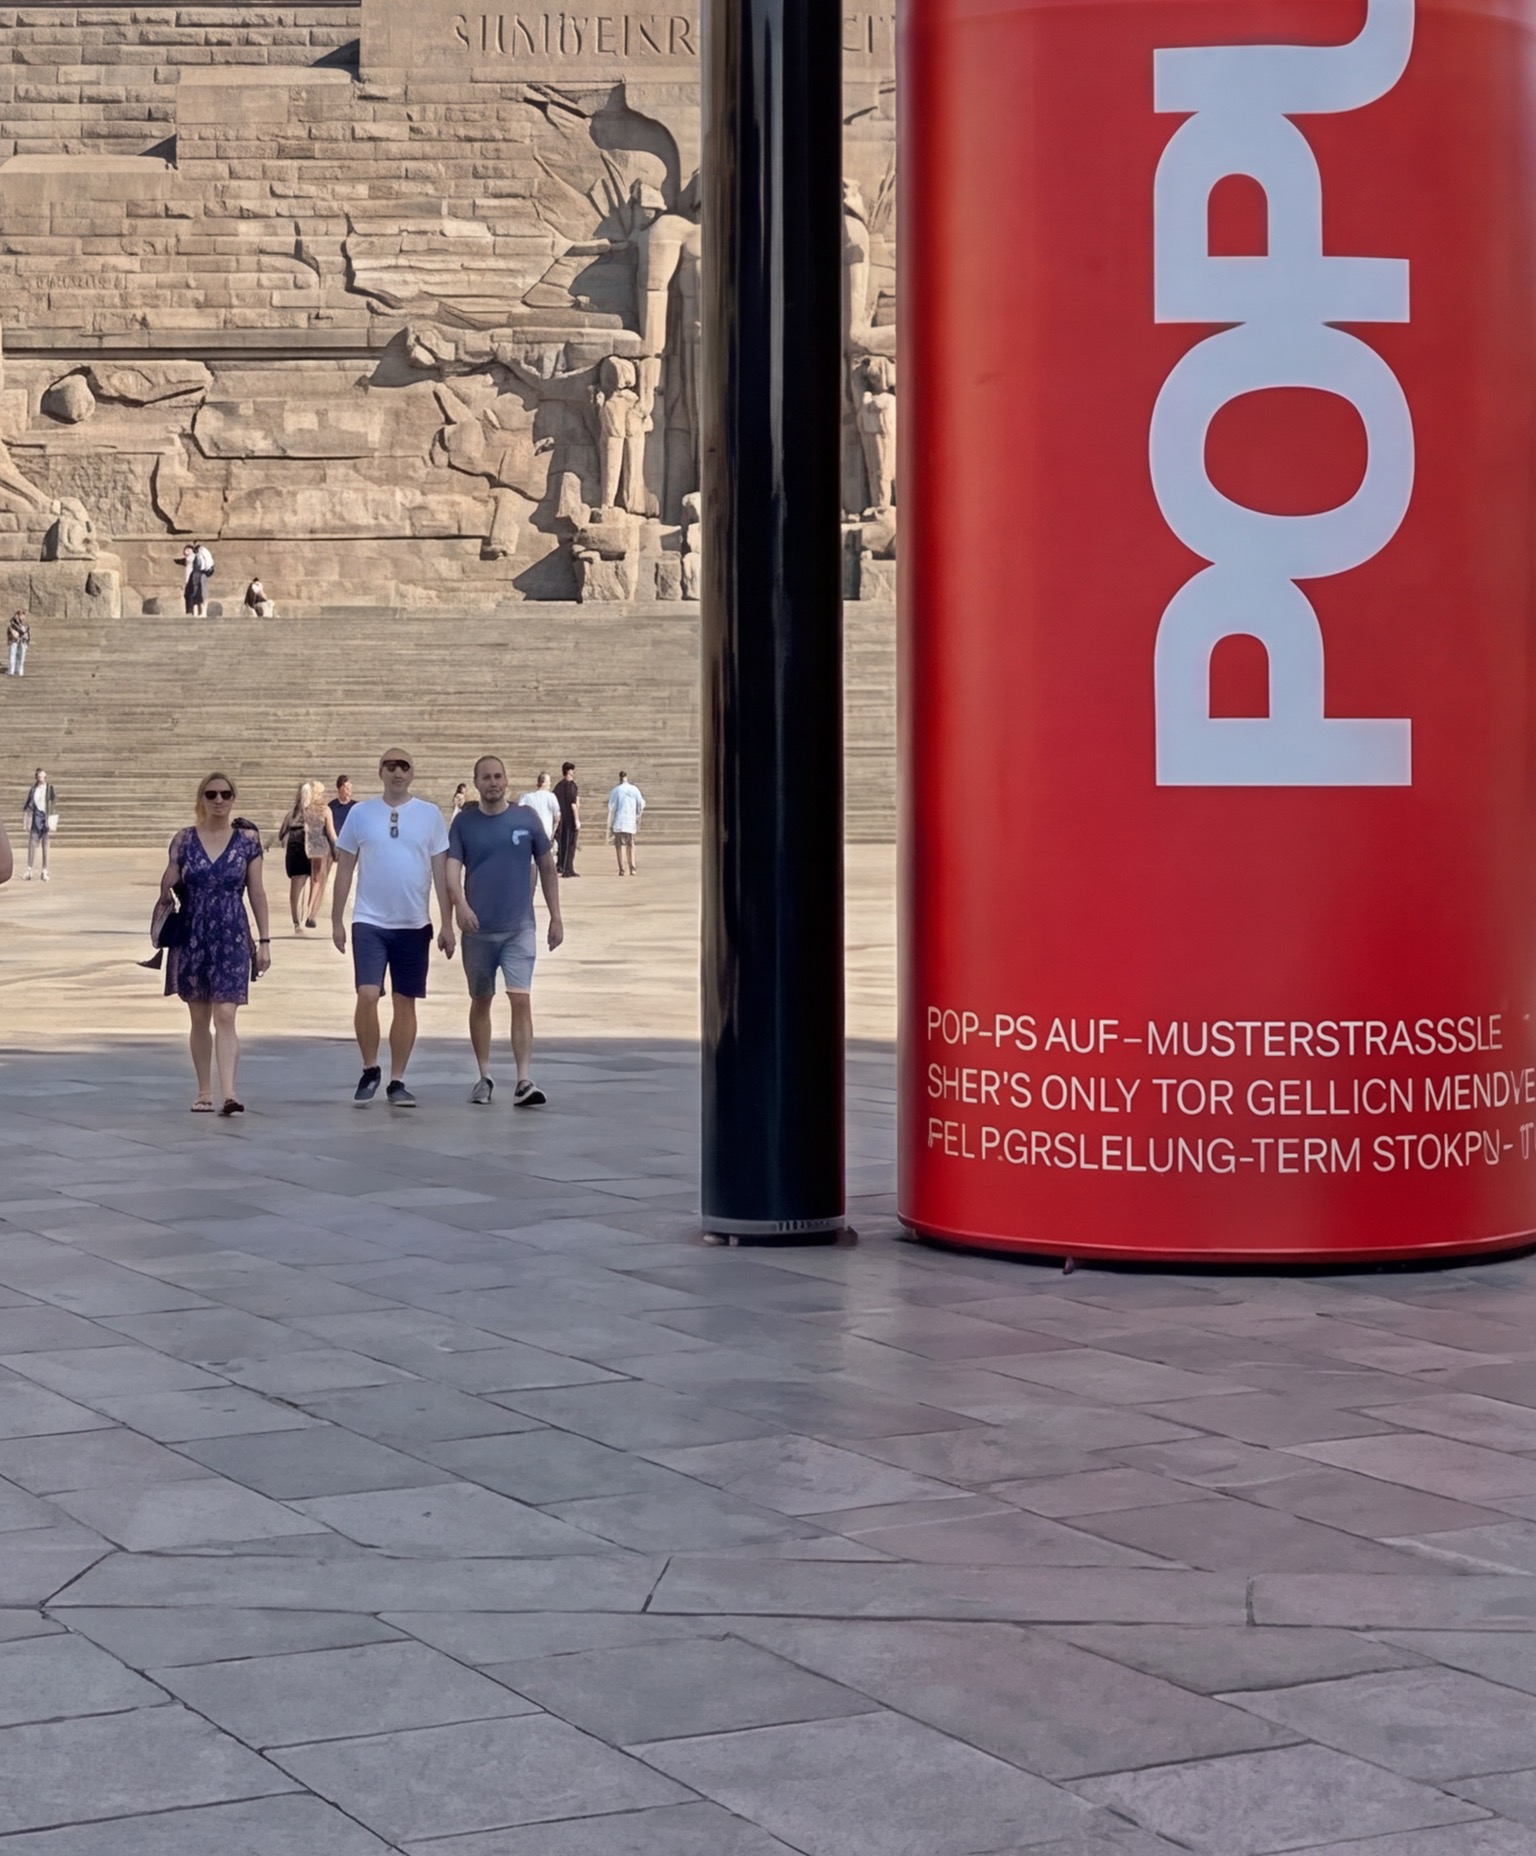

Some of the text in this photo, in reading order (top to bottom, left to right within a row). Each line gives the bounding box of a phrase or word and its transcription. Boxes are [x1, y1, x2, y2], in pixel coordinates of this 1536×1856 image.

[927, 1062, 1033, 1108] SHER'S
[1041, 1074, 1142, 1113] ONLY
[1151, 1078, 1234, 1116] TOR
[1246, 1077, 1413, 1116] GELLICN
